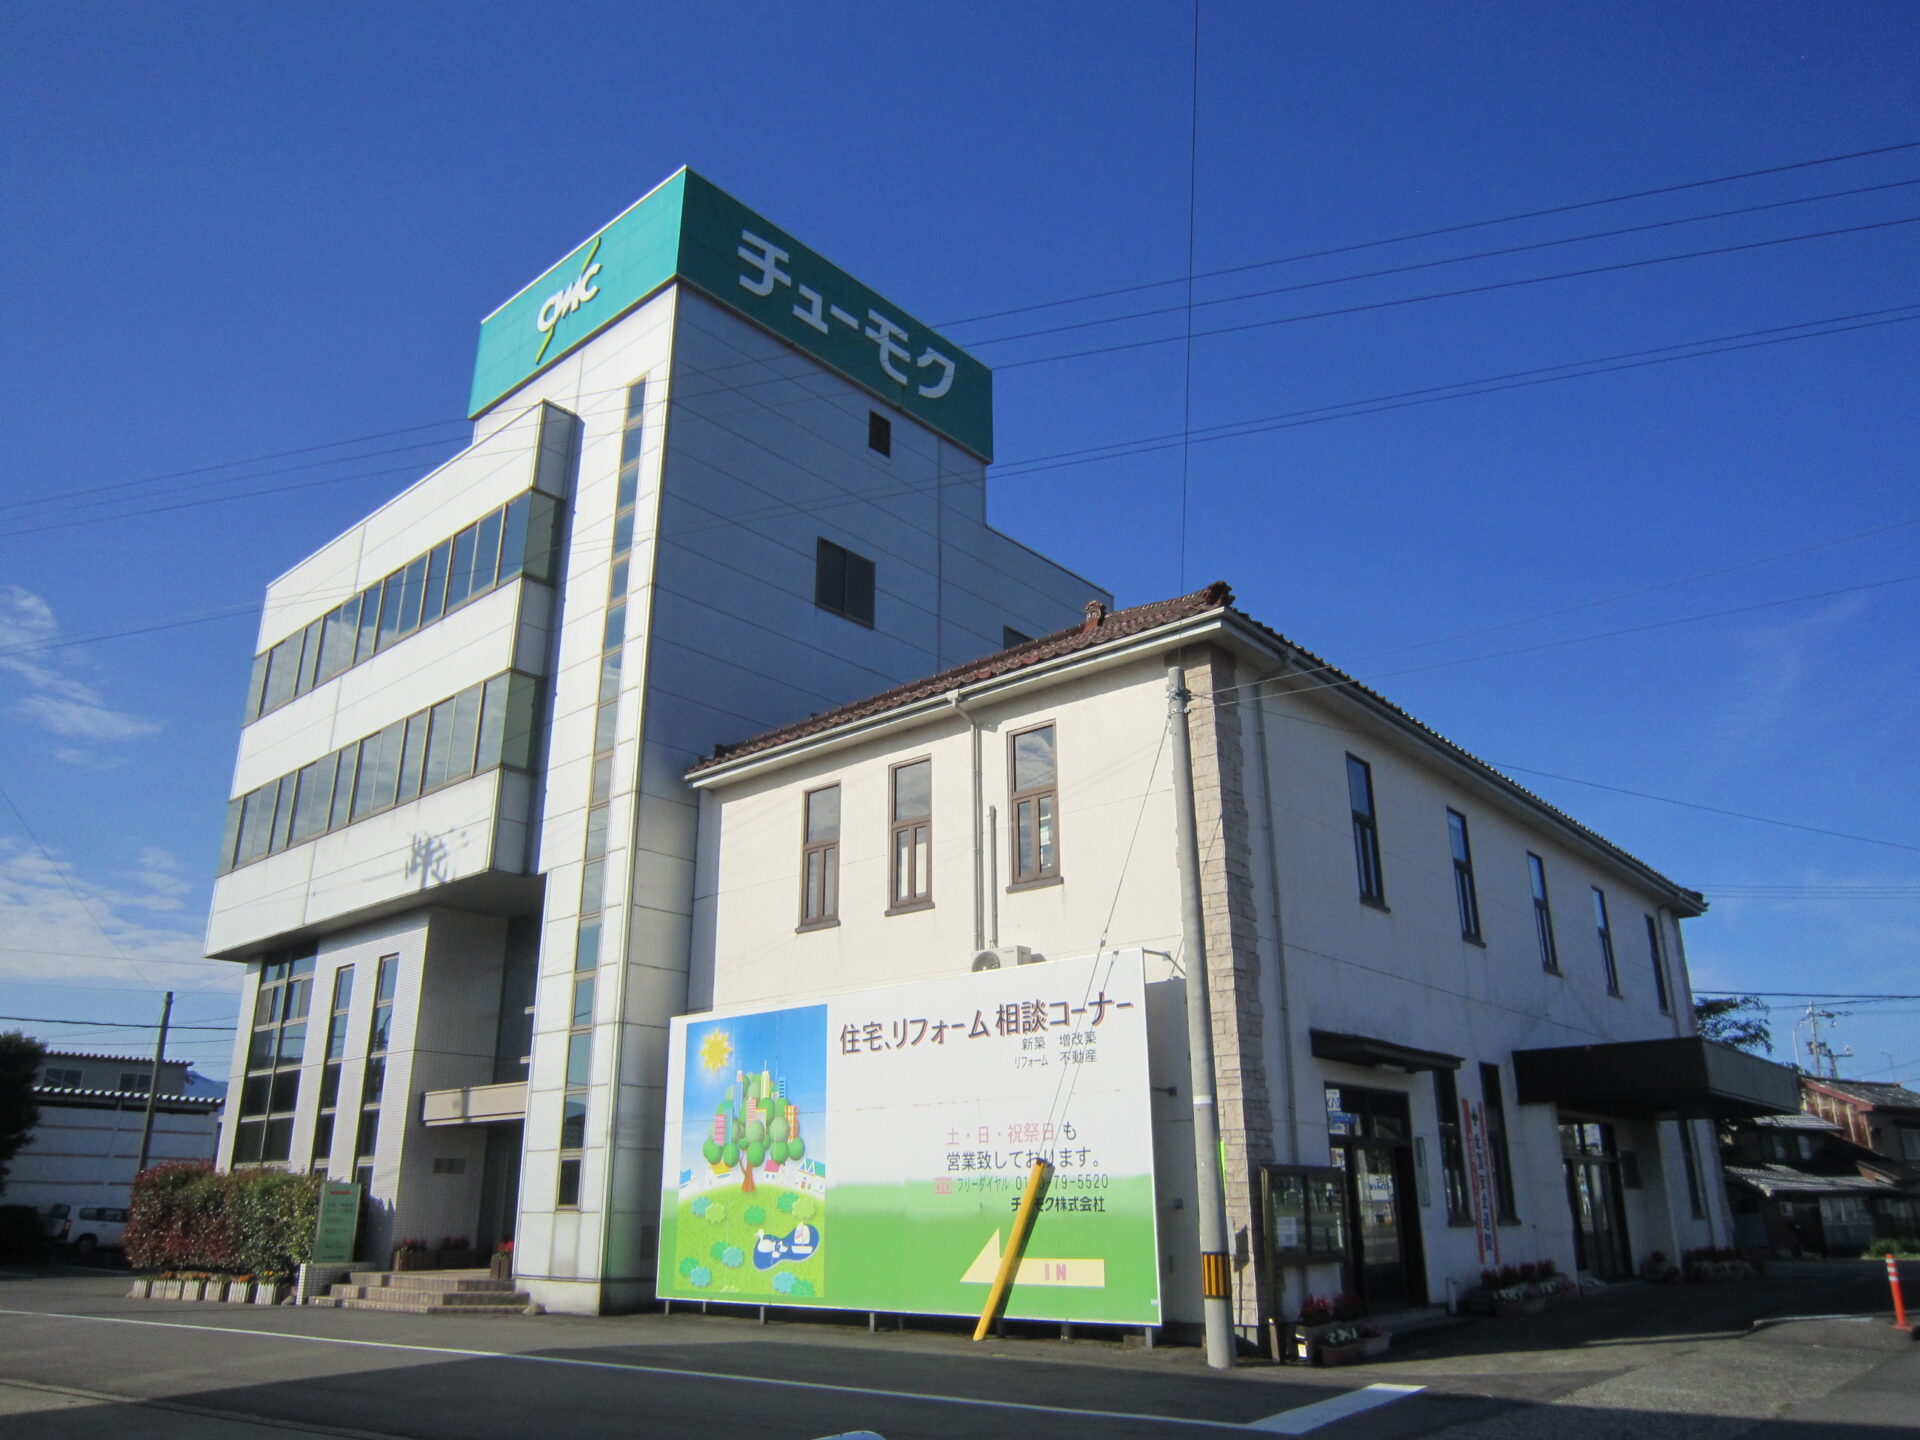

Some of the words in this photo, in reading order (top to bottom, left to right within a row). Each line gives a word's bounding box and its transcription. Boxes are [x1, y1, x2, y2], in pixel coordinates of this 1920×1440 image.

[738, 229, 956, 399] チューモク
[1022, 1035, 1046, 1051] 新築
[1059, 1031, 1097, 1047] 増改築
[1014, 1054, 1049, 1069] リフォーム
[1059, 1049, 1097, 1065] 不動産
[946, 1146, 1099, 1172] 営業致しております。
[957, 1175, 1010, 1193] フリーダイヤル
[1015, 1173, 1109, 1191] 010-79-5520
[1011, 1196, 1106, 1213] チモク株式会社
[1044, 1263, 1067, 1281] IN
